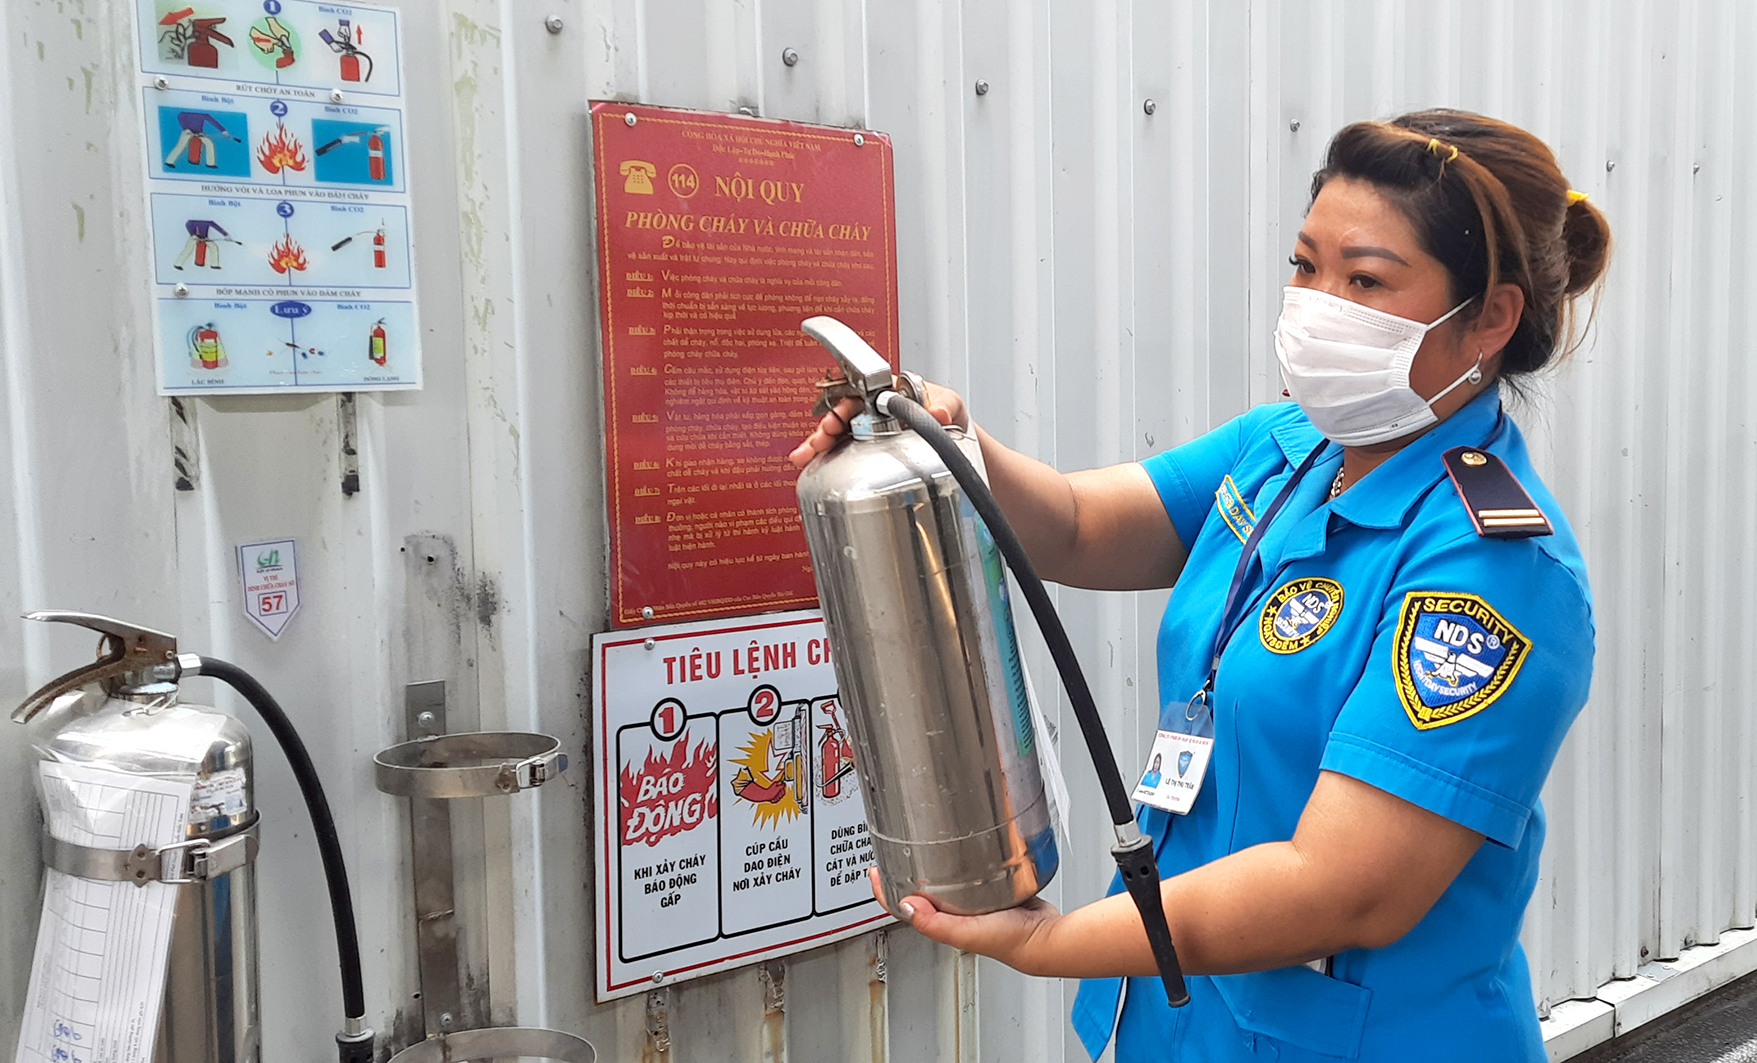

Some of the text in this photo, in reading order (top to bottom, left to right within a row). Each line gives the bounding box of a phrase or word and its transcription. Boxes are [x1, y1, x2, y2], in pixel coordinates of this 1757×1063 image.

[273, 103, 286, 115] 2
[672, 172, 696, 188] 114
[714, 171, 804, 204] NỘI QUY
[279, 204, 291, 216] 3
[624, 208, 872, 242] PHÒNG CHÁY VÀ CHỮA CHÁY
[262, 594, 284, 612] 57
[1302, 593, 1325, 614] NDS
[1423, 598, 1514, 644] SECURITY
[1434, 619, 1485, 654] NDS
[663, 646, 722, 685] TIÊU
[733, 639, 798, 680] LỆNH
[1438, 682, 1478, 696] SECURITY
[755, 690, 774, 719] 2
[658, 707, 674, 735] 1
[636, 767, 686, 804] BÁO
[626, 792, 703, 842] ĐỘNG
[831, 826, 856, 840] DÙNG
[745, 836, 790, 856] CÚP CẦU
[830, 840, 854, 855] CHỮA
[634, 854, 706, 880] KHI XẢY CHÁY
[744, 852, 791, 874] DAO ĐIỆN
[826, 858, 844, 872] CÁT
[846, 854, 858, 867] VÀ
[644, 874, 697, 895] BÁO ĐỘNG
[732, 866, 802, 892] NƠI XẢY CHÁY
[844, 869, 861, 884] DẬP
[660, 891, 682, 908] GẤP
